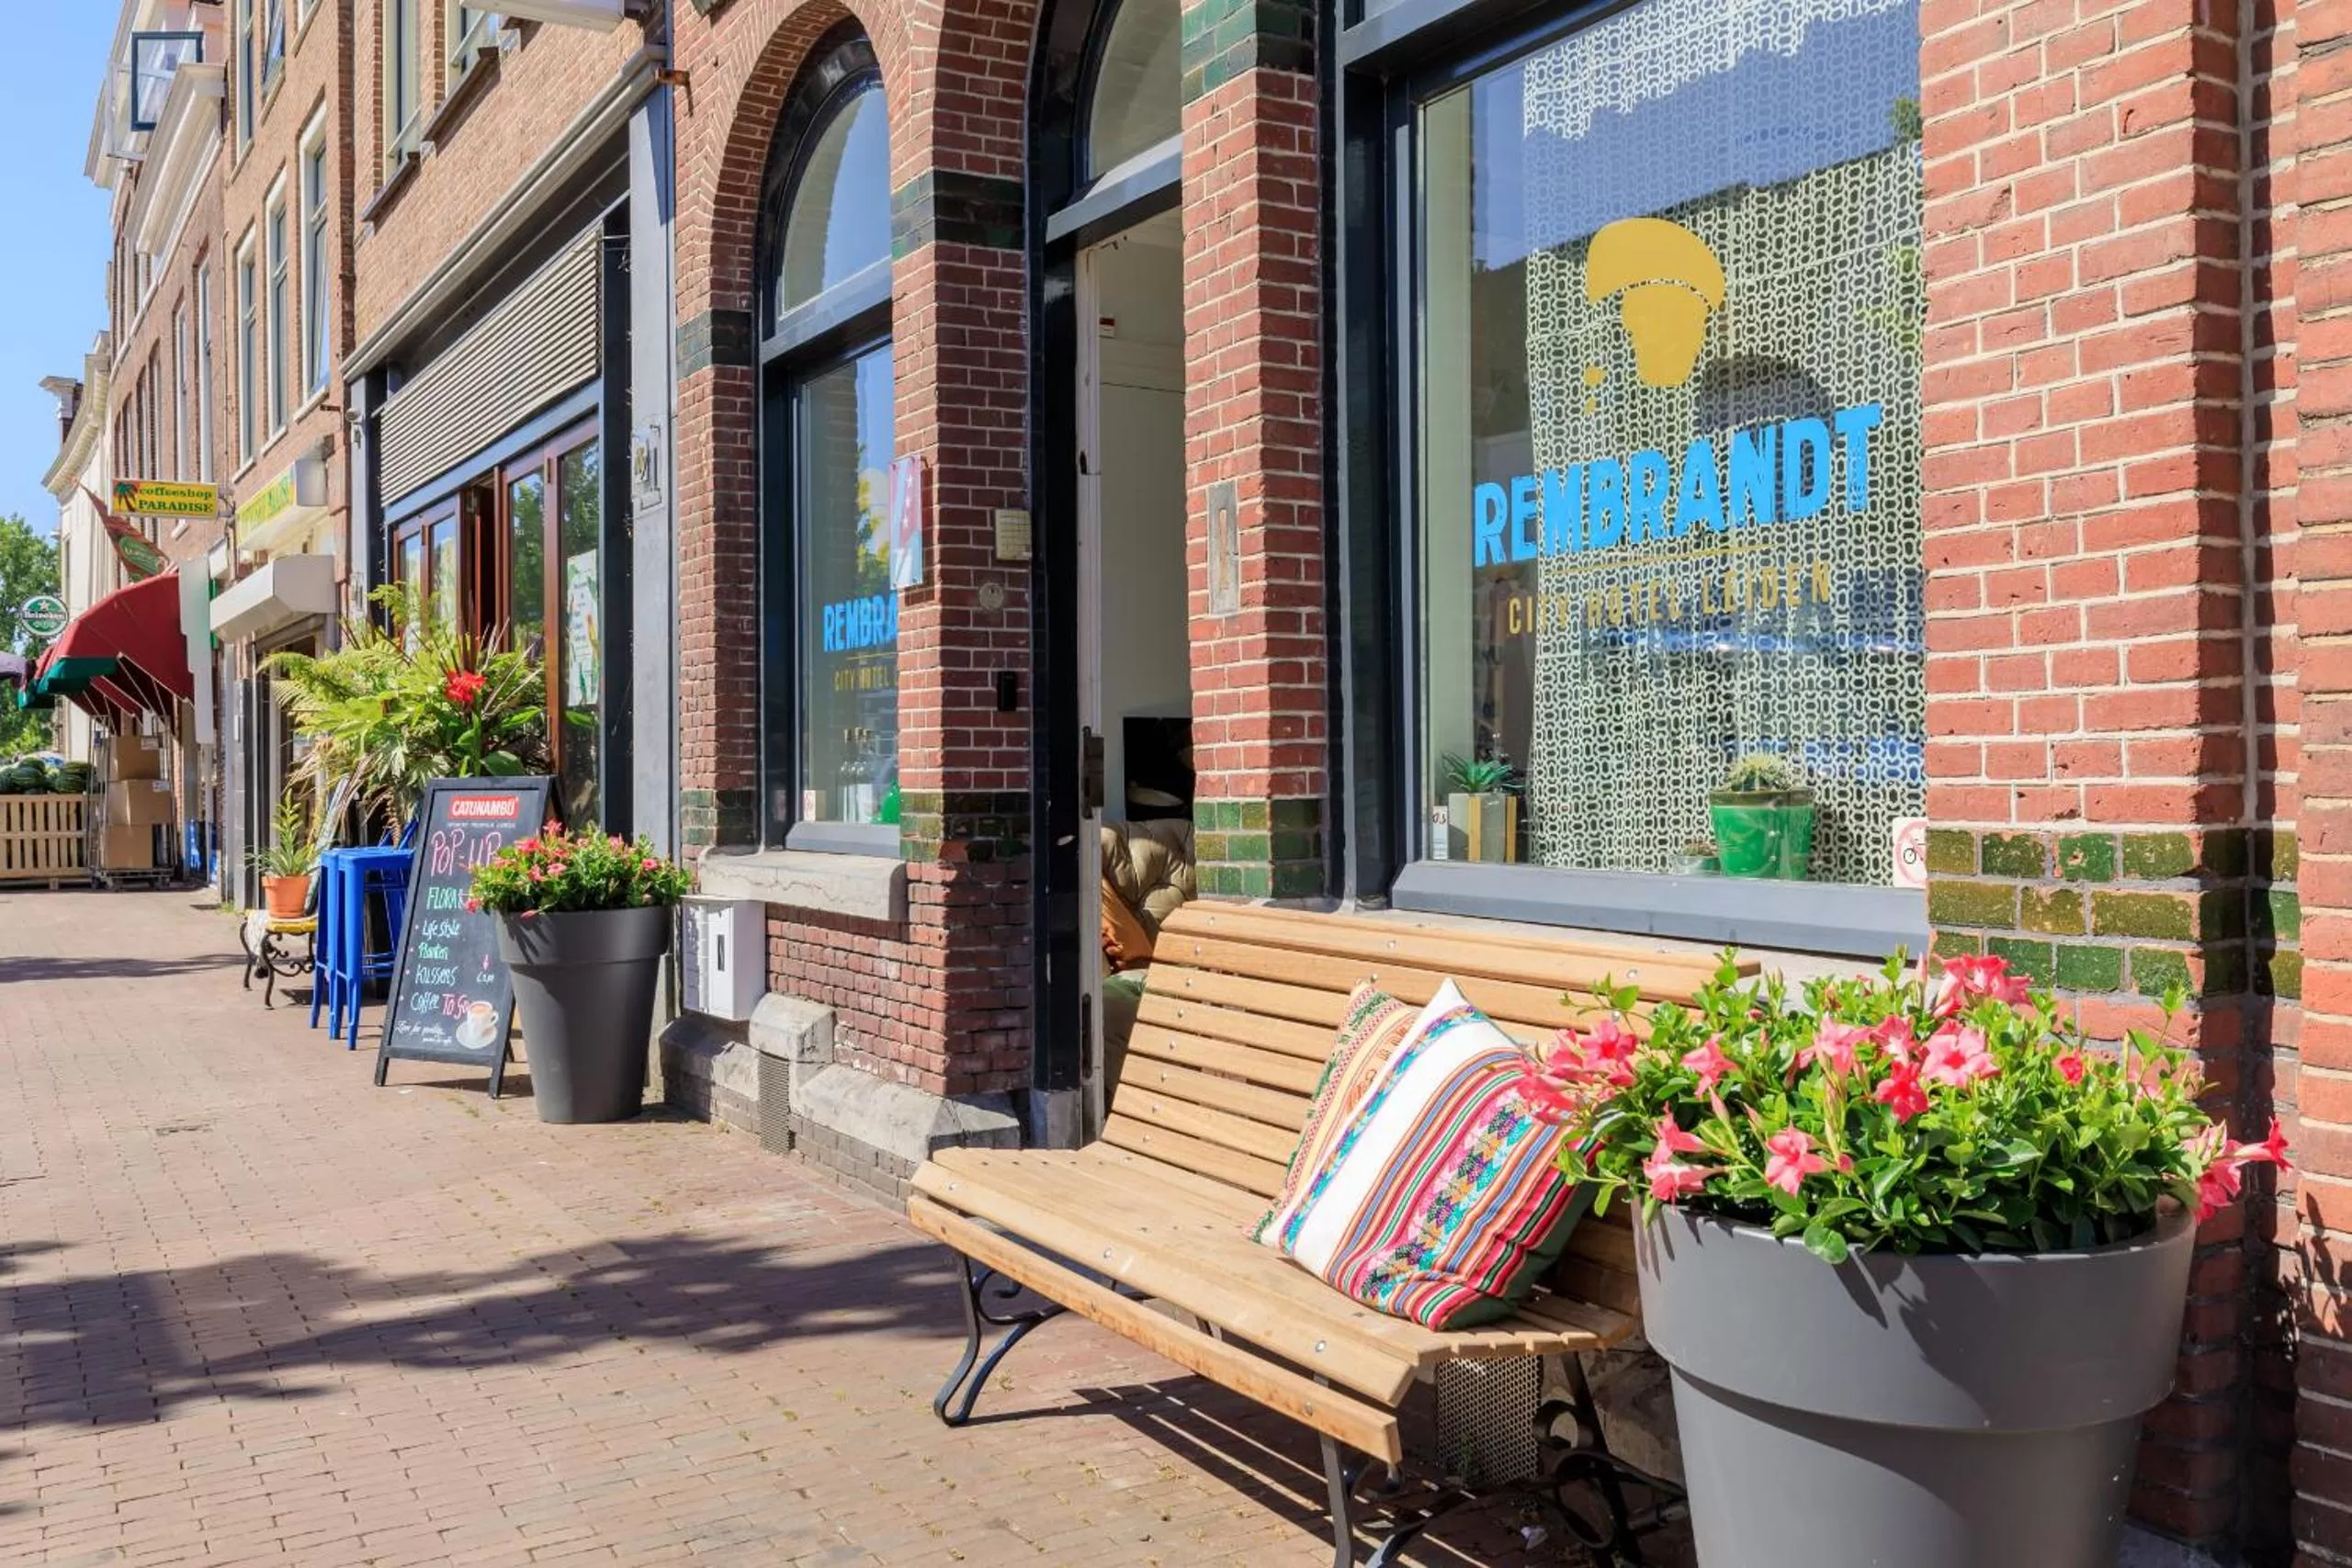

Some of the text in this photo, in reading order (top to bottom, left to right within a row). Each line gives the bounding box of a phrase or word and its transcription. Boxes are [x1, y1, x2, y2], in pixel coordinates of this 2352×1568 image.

[139, 486, 211, 500] coffeeshop
[1474, 401, 1883, 568] REMBRANDT
[139, 500, 213, 512] PARADISE
[1508, 559, 1832, 635] CITY HOTEL LEIDEN
[834, 669, 854, 691] CITY
[859, 666, 889, 689] HOTEL
